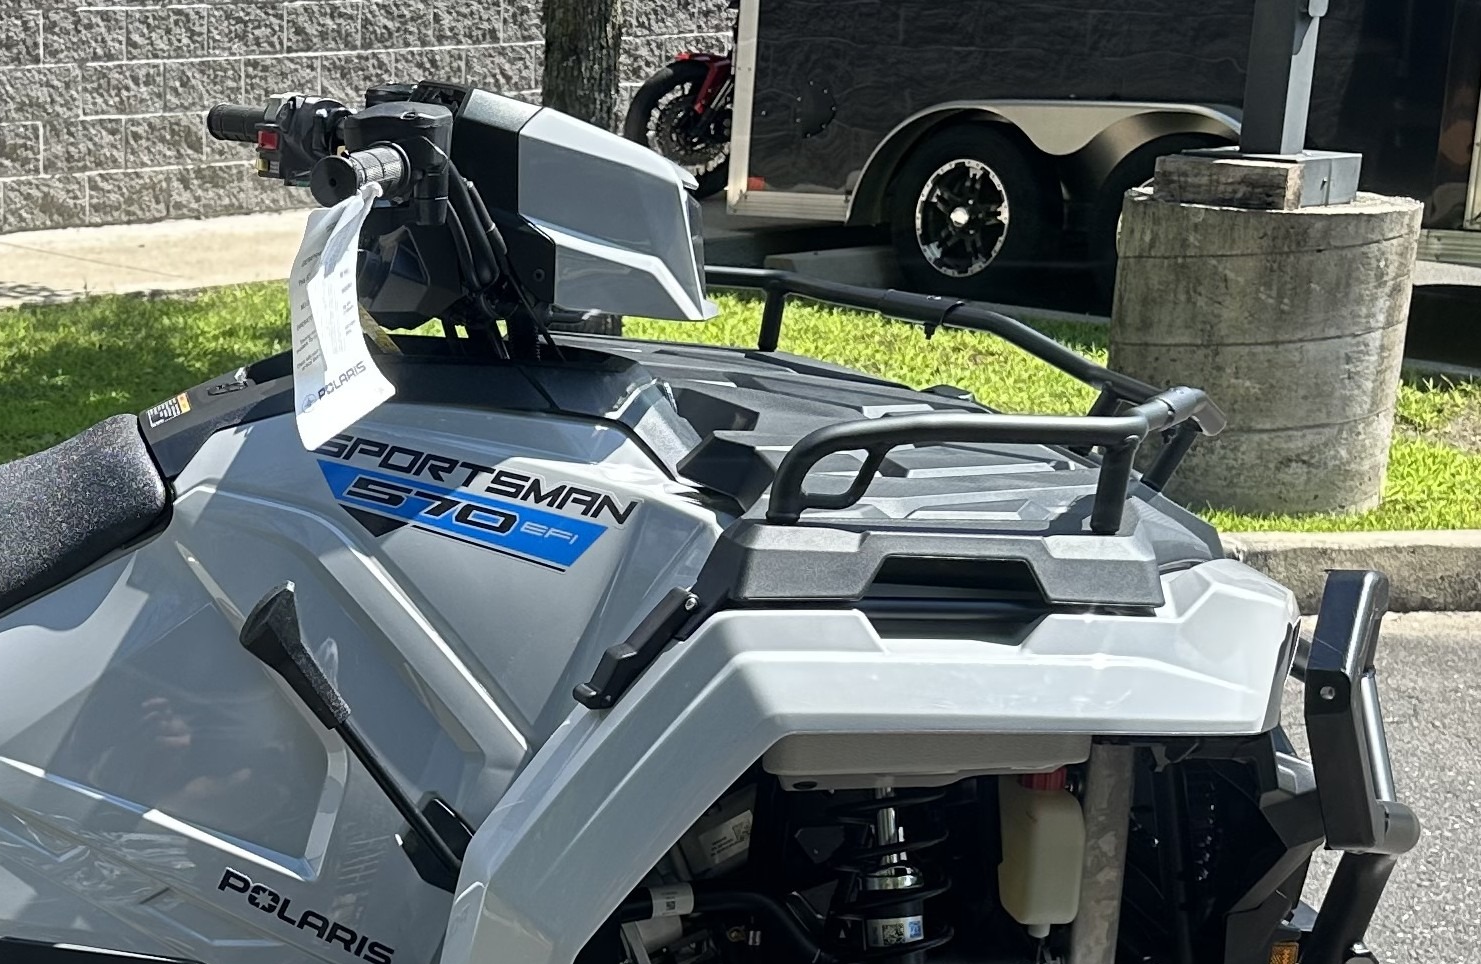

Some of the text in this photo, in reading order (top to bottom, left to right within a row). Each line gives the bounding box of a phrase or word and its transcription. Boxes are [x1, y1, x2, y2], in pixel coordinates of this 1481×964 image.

[317, 360, 367, 400] POLARIS
[316, 435, 638, 524] SPORTSMAN
[346, 475, 578, 545] 570 EFI
